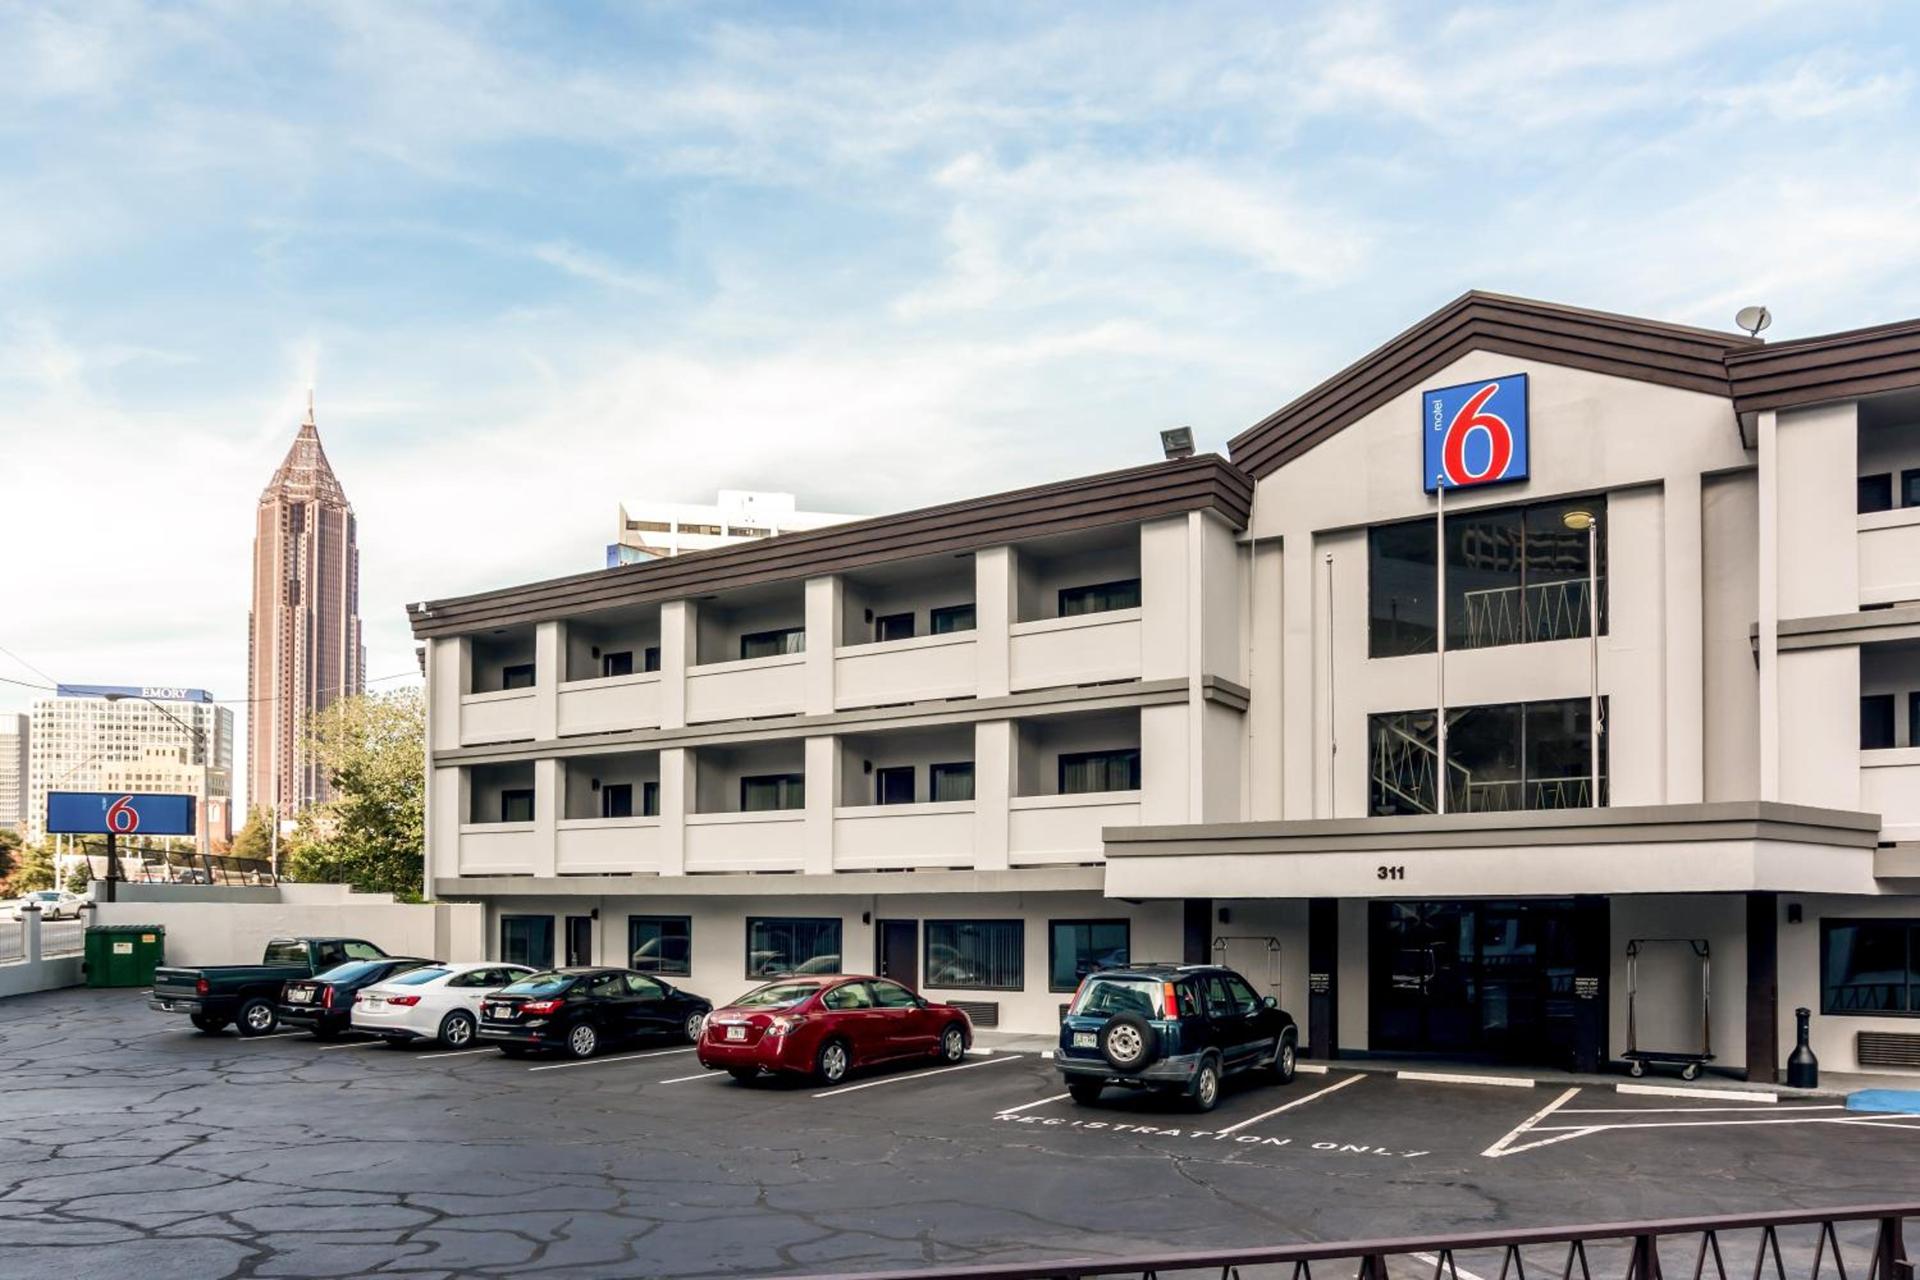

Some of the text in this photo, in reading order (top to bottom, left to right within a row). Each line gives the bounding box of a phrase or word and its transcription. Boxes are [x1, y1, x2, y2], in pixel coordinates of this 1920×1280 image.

[1432, 383, 1513, 485] motel 6
[143, 688, 187, 699] EMORY
[106, 795, 140, 833] 6
[1377, 866, 1405, 880] 311
[993, 1114, 1431, 1157] REGISTRATION ONLY
